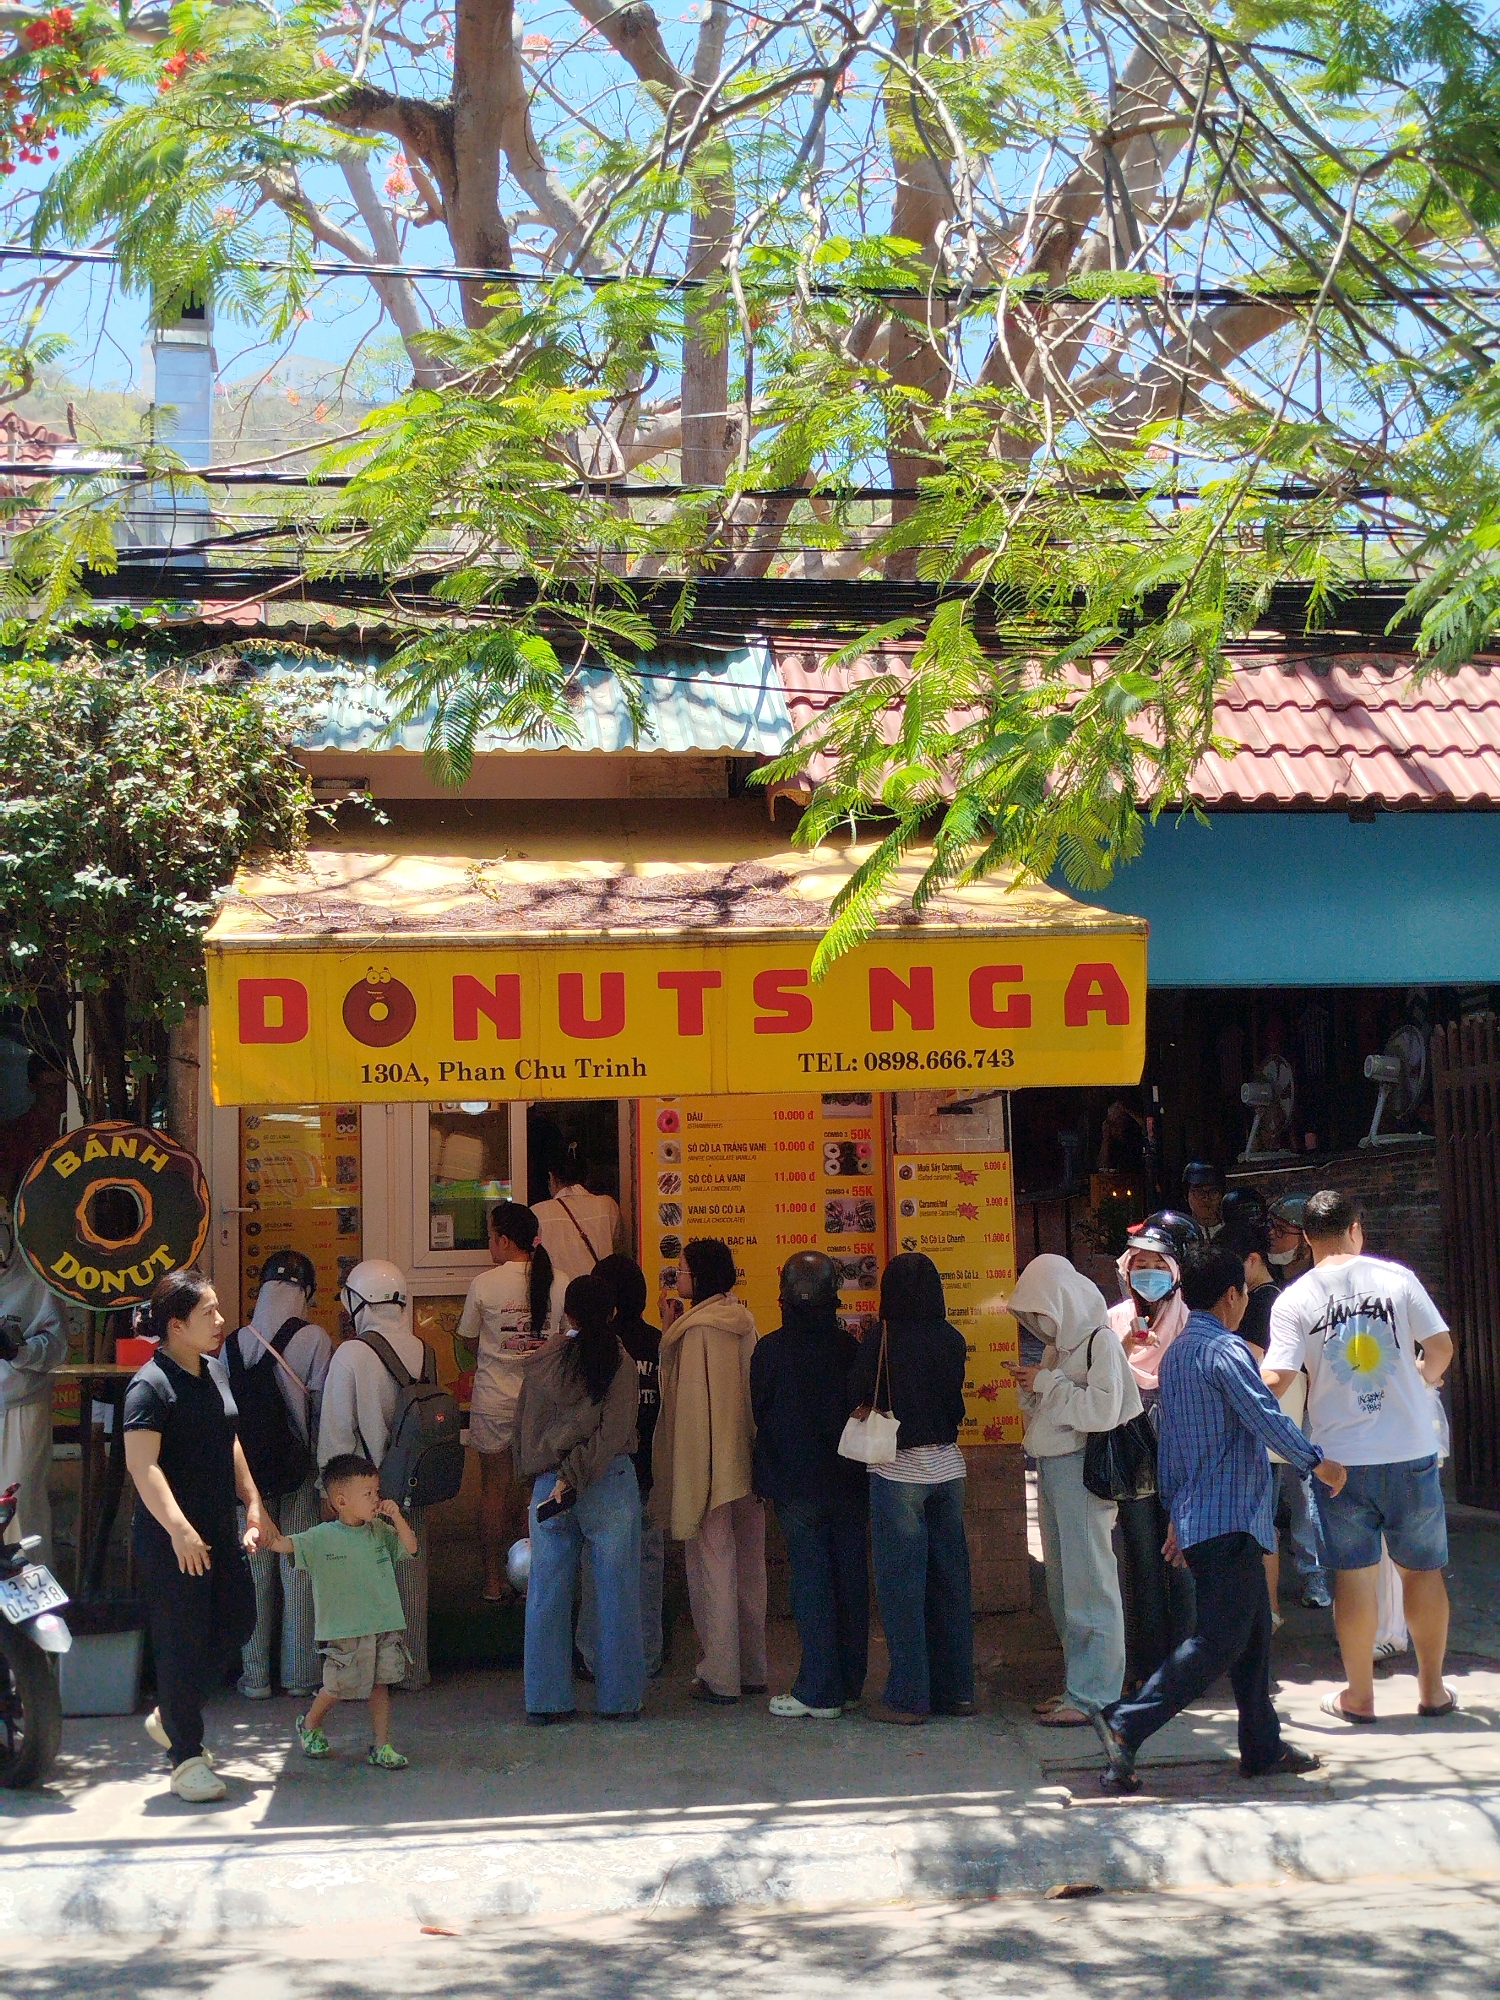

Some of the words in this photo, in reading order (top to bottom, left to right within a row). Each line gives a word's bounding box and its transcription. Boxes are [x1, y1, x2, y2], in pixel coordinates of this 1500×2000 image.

[238, 966, 813, 1047] DONUTS
[868, 963, 1130, 1032] NGA
[798, 1052, 858, 1073] TEL:
[864, 1048, 1015, 1072] 0898.666.743
[361, 1063, 429, 1086] 130A,
[438, 1061, 506, 1082] Phan
[514, 1058, 567, 1080] Chu
[574, 1057, 647, 1078] Trinh
[773, 1110, 805, 1120] 10.000
[851, 1128, 872, 1140] 50K
[711, 1143, 721, 1152] LA
[774, 1141, 806, 1151] 10.000
[52, 1133, 170, 1179] BÁNH
[714, 1174, 726, 1183] LA
[726, 1174, 747, 1183] VANI
[774, 1172, 807, 1182] 11.000
[852, 1185, 874, 1197] 55K
[687, 1205, 707, 1215] VANI
[735, 1204, 746, 1214] LA
[775, 1203, 808, 1213] 11.000
[775, 1234, 808, 1244] 11.000
[946, 1233, 965, 1243] Chanh
[984, 1232, 1004, 1243] 11.000
[854, 1243, 875, 1254] 55K
[50, 1244, 176, 1293] DONUT
[855, 1301, 877, 1312] 55K
[7, 1586, 62, 1619] 045.38
